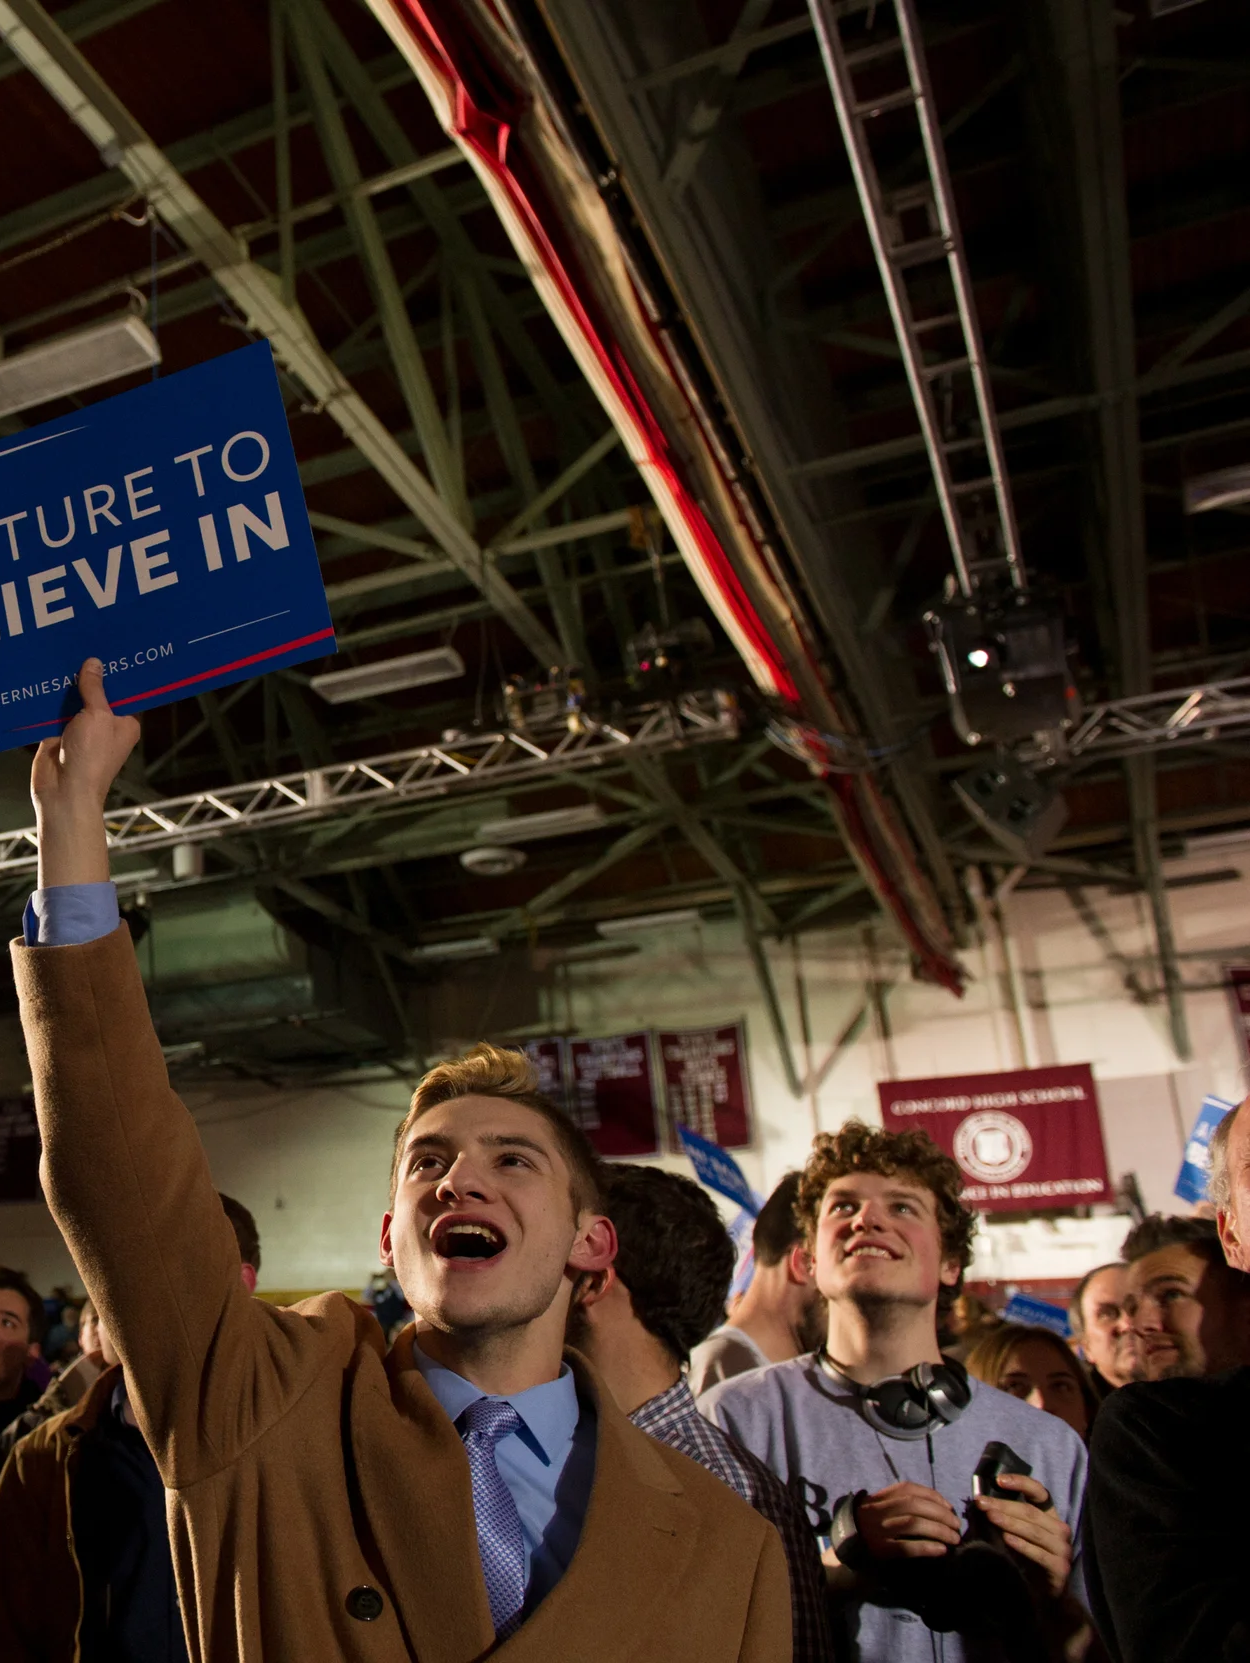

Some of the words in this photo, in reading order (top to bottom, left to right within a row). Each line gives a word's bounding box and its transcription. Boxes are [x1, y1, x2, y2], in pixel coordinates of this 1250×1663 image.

[173, 430, 270, 498] TO
[197, 491, 291, 573] IN
[890, 1094, 972, 1117] CONCORD
[972, 1091, 1018, 1109] HIGH
[1018, 1085, 1086, 1105] SCHOOL
